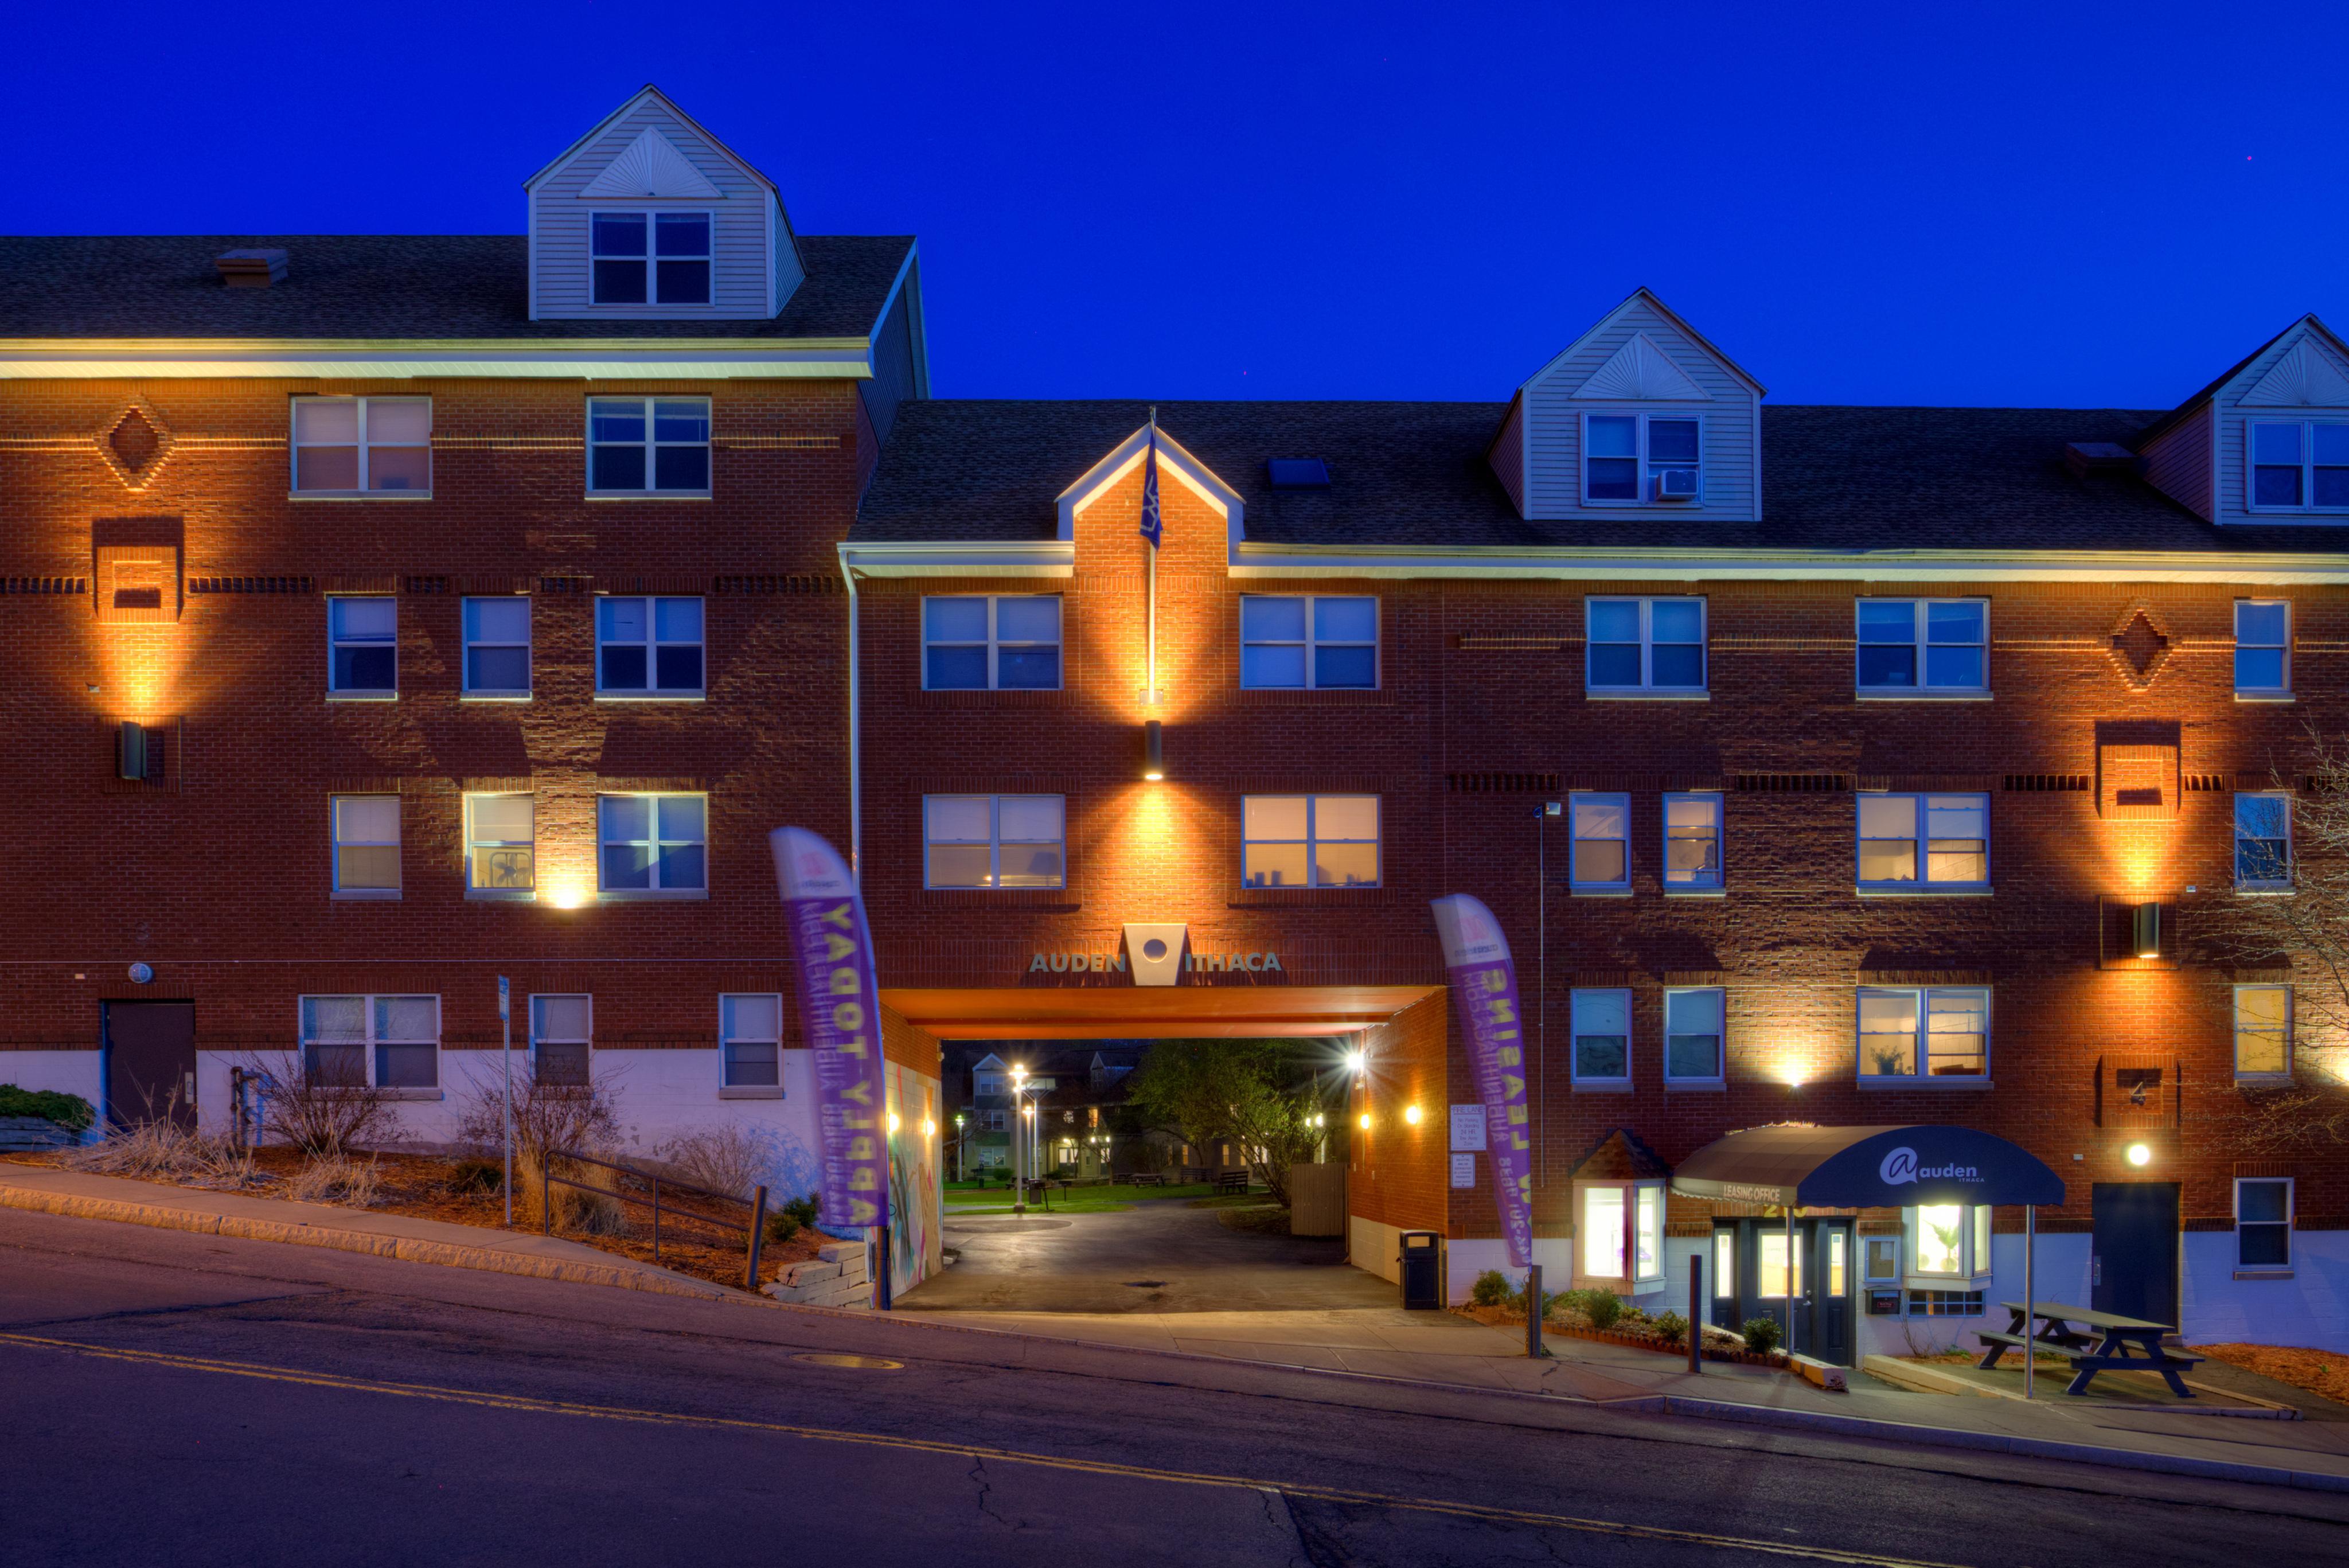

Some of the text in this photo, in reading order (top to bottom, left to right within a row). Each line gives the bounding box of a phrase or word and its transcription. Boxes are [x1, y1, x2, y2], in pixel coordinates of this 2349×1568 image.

[1029, 952, 1282, 973] AUDEN ITHACA
[2131, 1082, 2146, 1102] 4
[1919, 1163, 1977, 1177] auden
[1724, 1185, 1780, 1202] LEASING OFFICE
